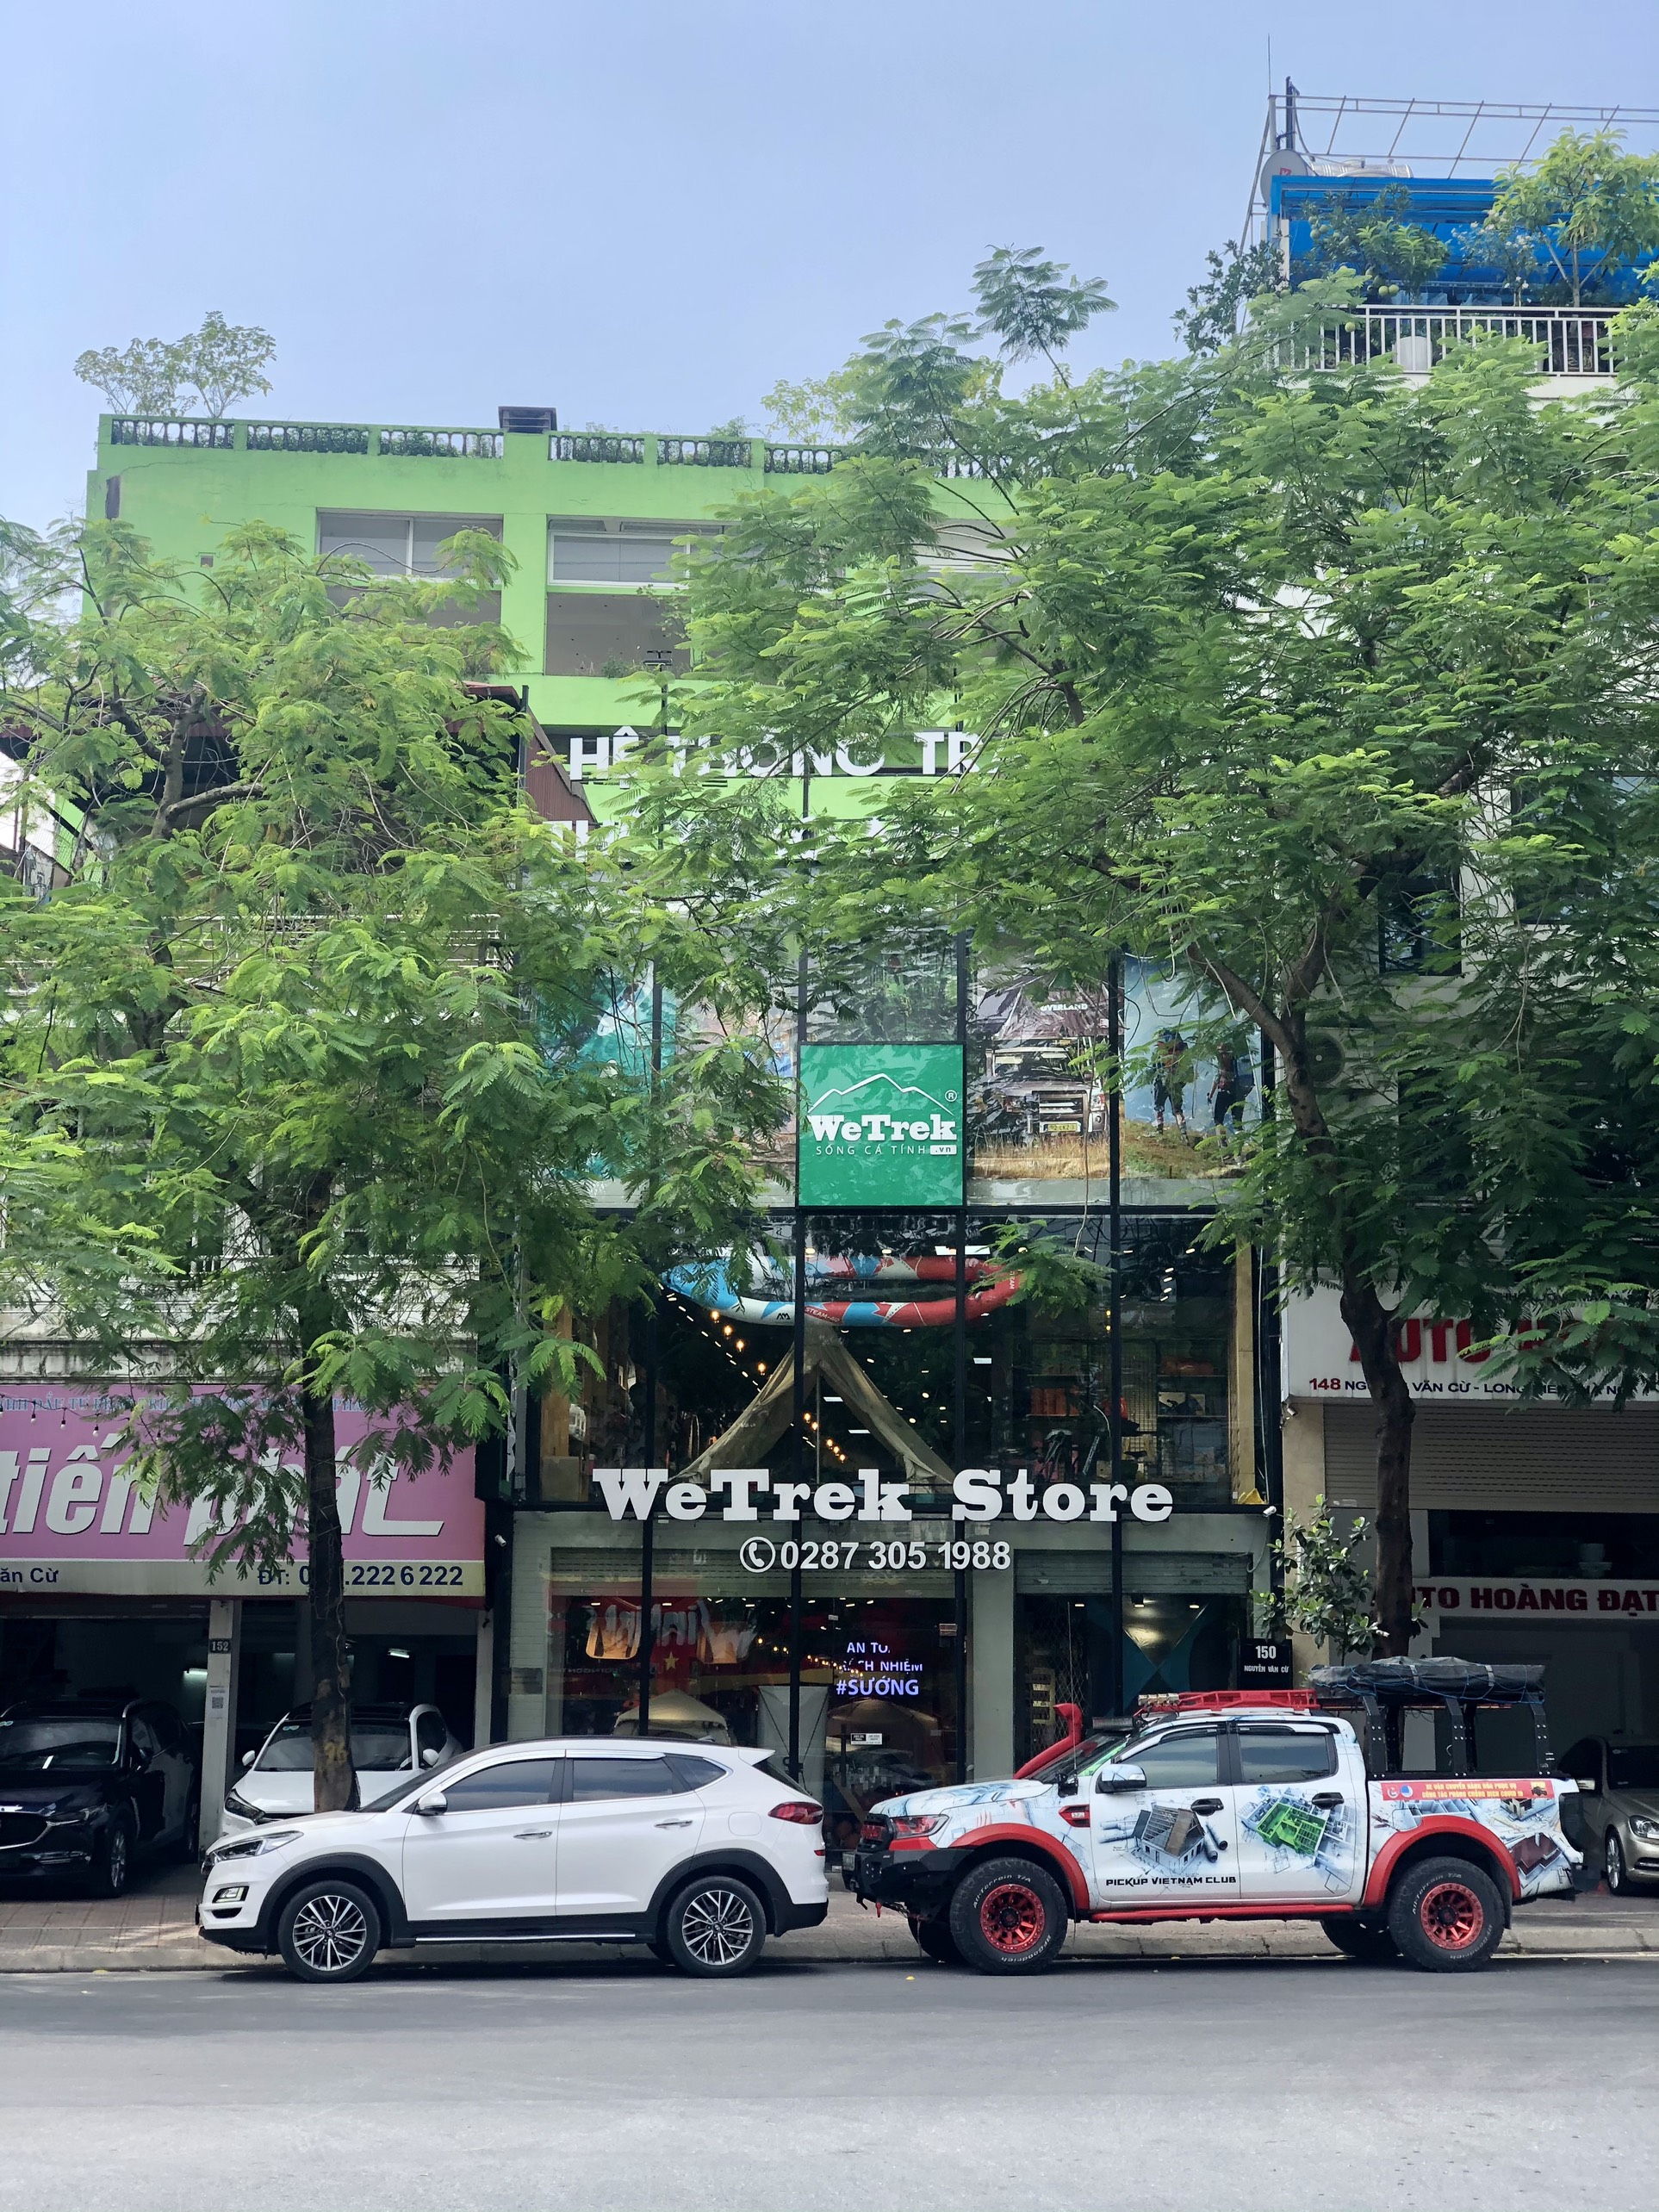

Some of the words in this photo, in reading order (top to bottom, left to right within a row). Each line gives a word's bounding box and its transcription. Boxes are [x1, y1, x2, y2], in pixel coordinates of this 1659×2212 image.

[807, 1114, 957, 1141] WeTrek
[864, 1143, 883, 1155] CÁ
[891, 1143, 926, 1155] TÍNH
[1349, 1319, 1491, 1363] UTO
[1309, 1378, 1341, 1390] 148
[1412, 1380, 1444, 1393] VĂN
[1447, 1380, 1471, 1393] CỪ
[593, 1468, 913, 1522] WeTrek
[952, 1468, 1174, 1522] Store
[780, 1542, 854, 1570] 0287
[868, 1542, 928, 1570] 305
[942, 1541, 1011, 1570] 1988
[30, 1568, 59, 1582] Cừ
[1470, 1583, 1588, 1611] HOÀNG
[1598, 1589, 1659, 1617] ĐẠT
[211, 1641, 229, 1651] 152
[1255, 1646, 1277, 1659] 150
[836, 1675, 919, 1695] #SƯỚNG
[1106, 1878, 1148, 1887] PICKUP
[1152, 1877, 1203, 1886] VIETNAM
